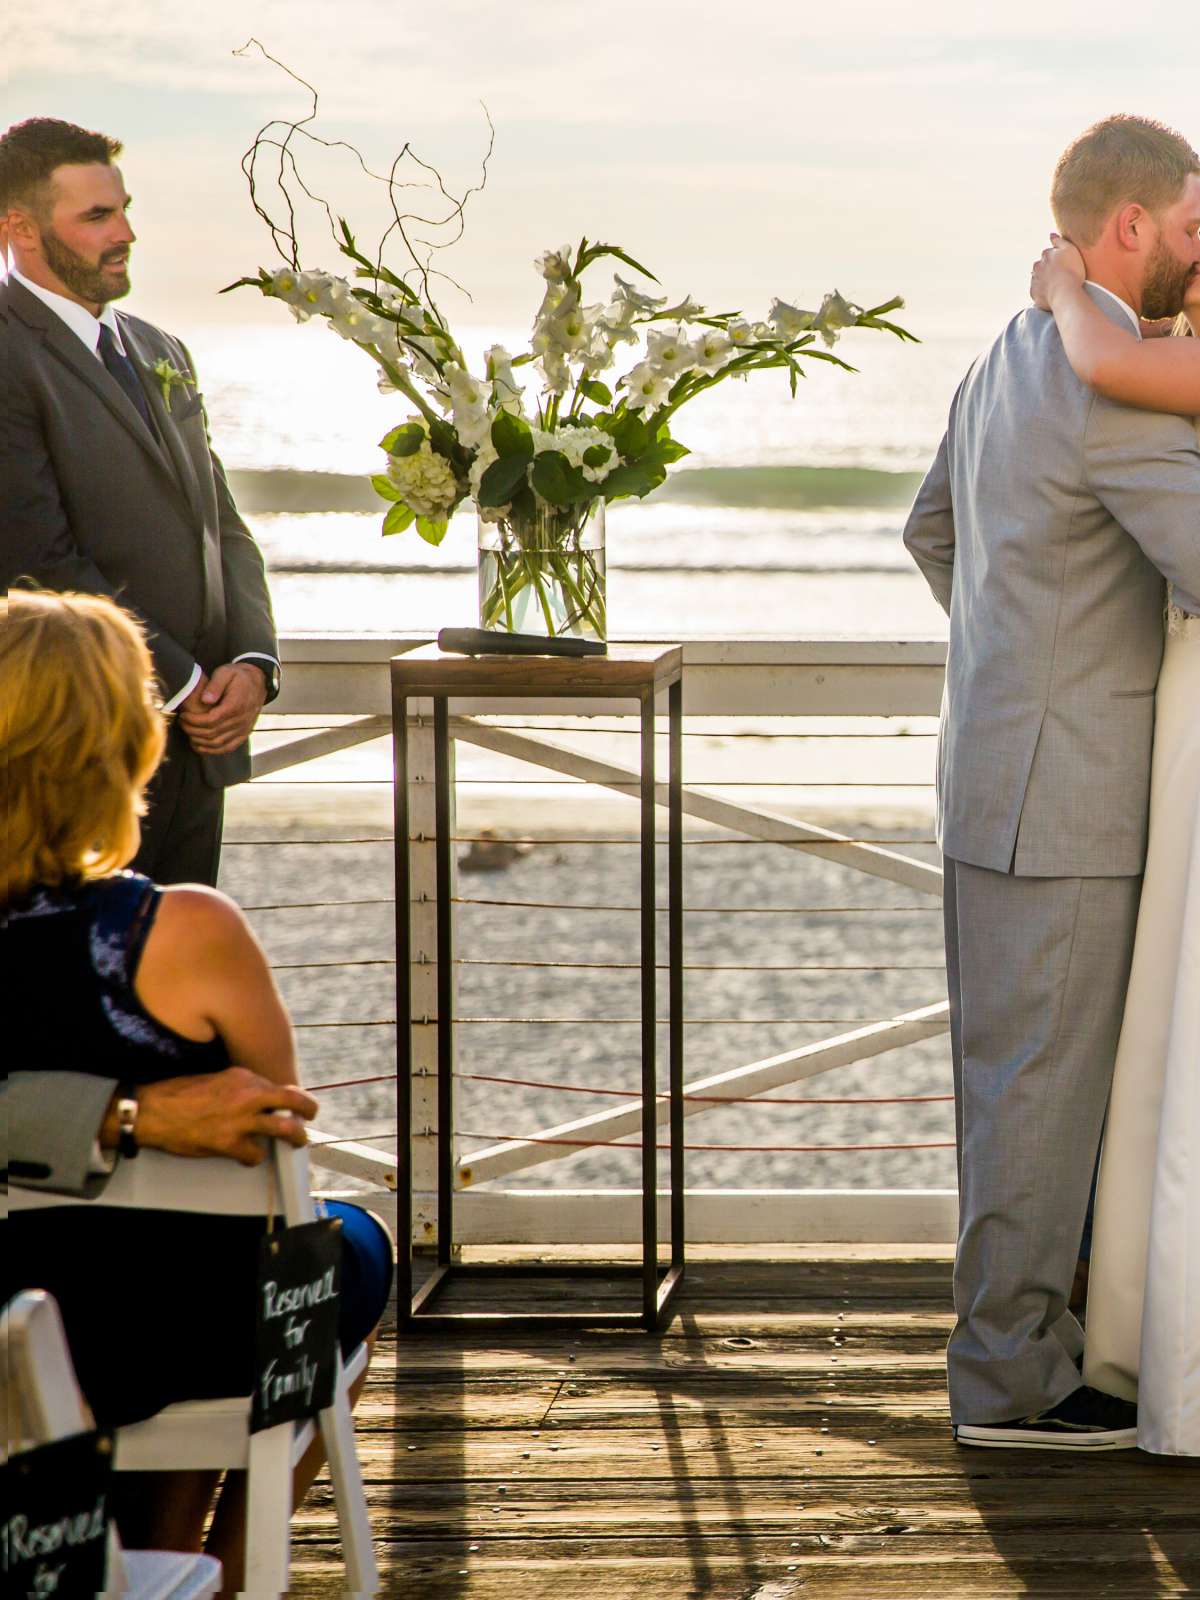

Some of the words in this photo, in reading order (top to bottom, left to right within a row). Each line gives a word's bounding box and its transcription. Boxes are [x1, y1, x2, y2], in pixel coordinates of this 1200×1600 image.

[263, 1265, 340, 1321] Reserved
[284, 1315, 312, 1349] for
[261, 1353, 318, 1410] Family
